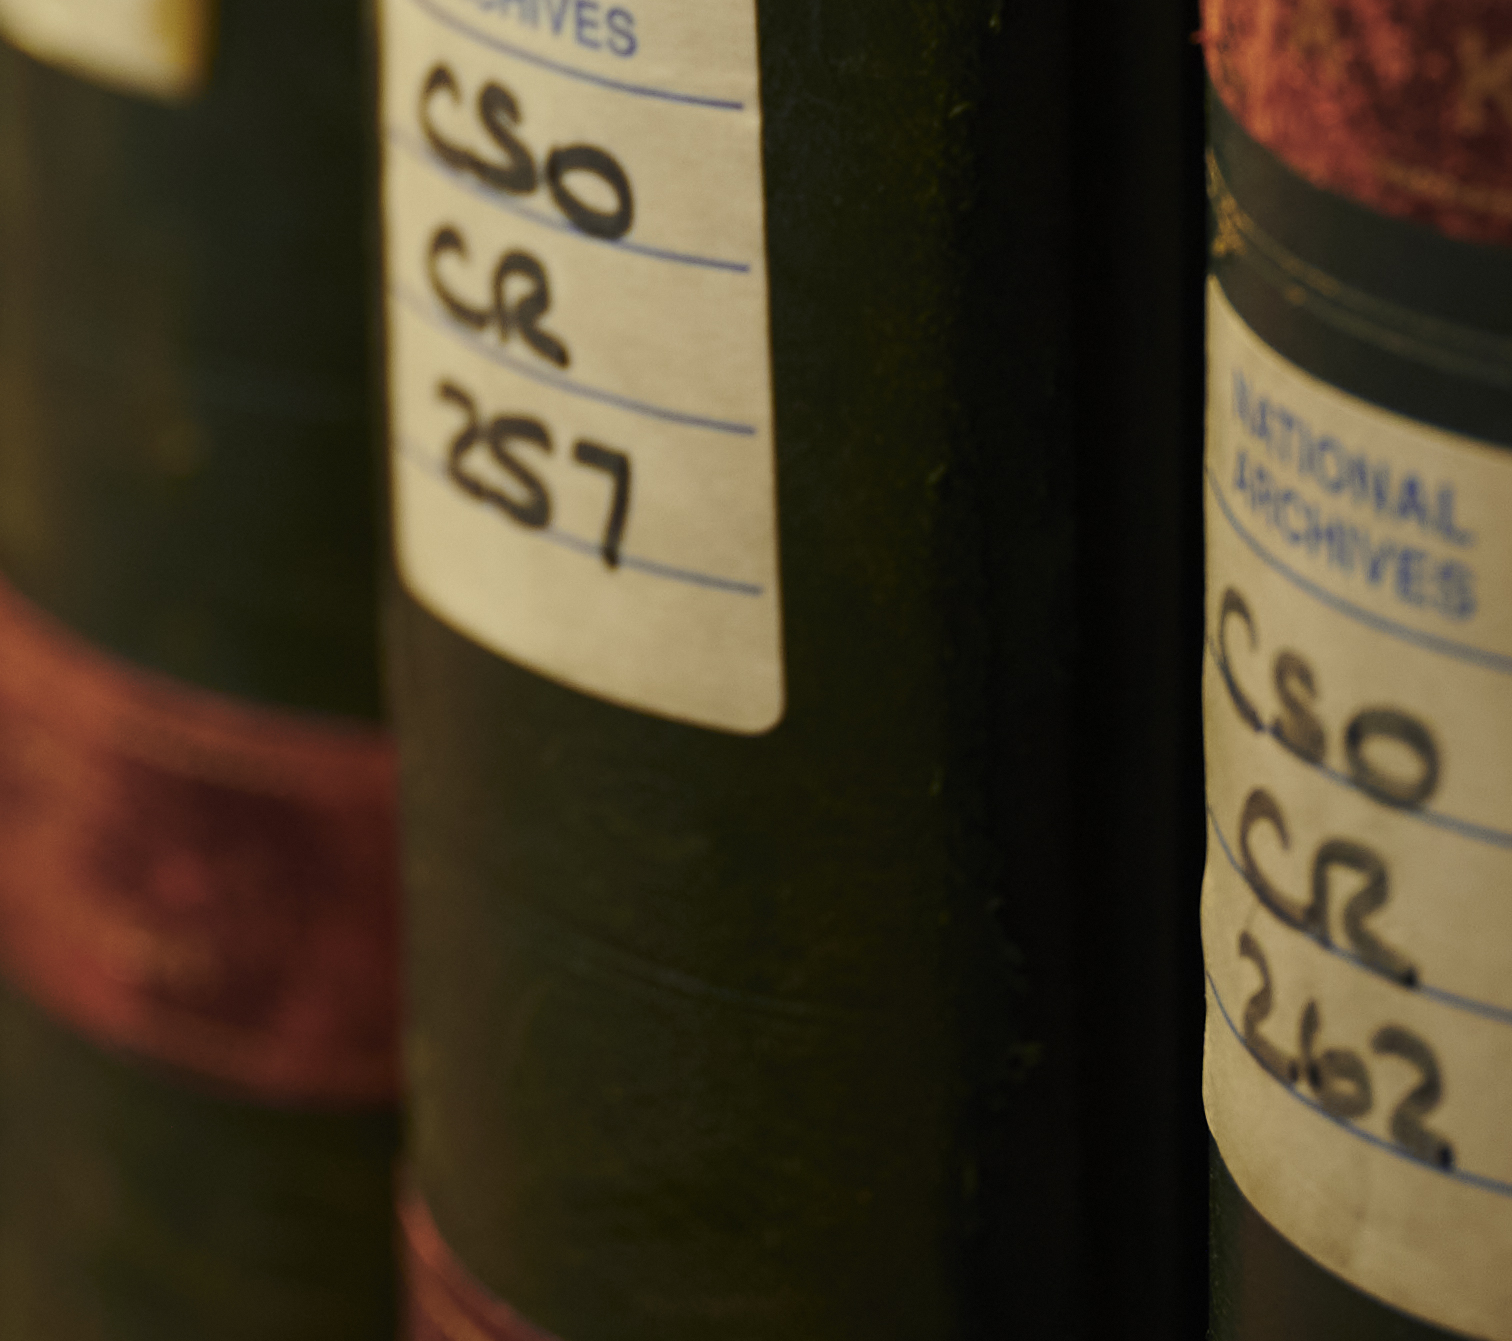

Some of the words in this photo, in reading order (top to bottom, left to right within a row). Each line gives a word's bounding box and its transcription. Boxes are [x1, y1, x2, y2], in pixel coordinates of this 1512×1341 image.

[417, 60, 636, 245] CSO
[426, 224, 572, 370] CR
[434, 378, 633, 571] 257
[1232, 370, 1478, 551] NATIONAL
[1233, 449, 1480, 623] ARCHIVES
[1236, 785, 1422, 991] CR
[1236, 924, 1457, 1173] 262
